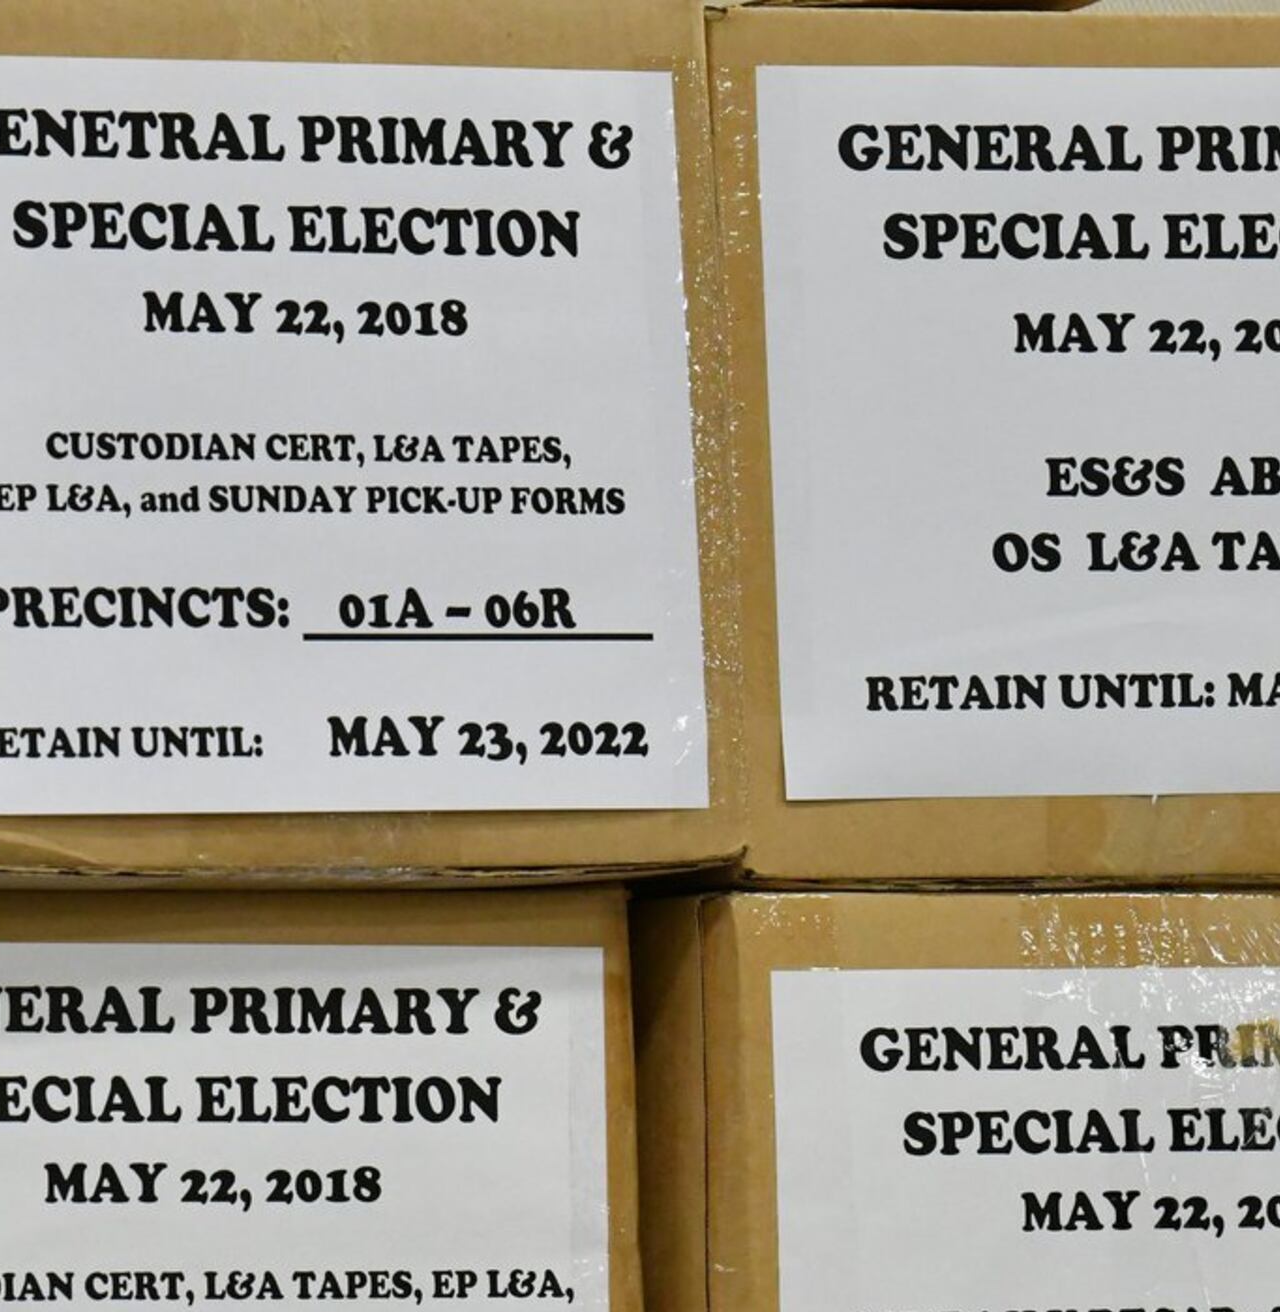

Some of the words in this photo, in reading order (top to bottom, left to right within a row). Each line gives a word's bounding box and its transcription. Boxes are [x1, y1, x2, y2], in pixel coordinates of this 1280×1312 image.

[298, 116, 573, 168] PRIMARY
[588, 121, 633, 169] &
[13, 200, 275, 252] SPECIAL
[287, 205, 580, 257] ELECTION
[1014, 313, 1135, 353] MAY
[1149, 320, 1221, 361] 22,
[46, 432, 255, 460] CUSTODIAN
[266, 434, 364, 467] CERT,
[373, 435, 445, 462] L&A
[452, 436, 571, 469] TAPES,
[1045, 456, 1185, 497] ES&S
[46, 484, 131, 518] L&A,
[141, 486, 200, 512] and
[209, 485, 357, 513] SUNDAY
[366, 487, 502, 514] PICK-UP
[511, 487, 625, 514] FORMS
[993, 533, 1061, 572] OS
[1087, 531, 1200, 571] L&A
[339, 587, 433, 628] 01A
[485, 588, 576, 628] 06R
[131, 727, 263, 757] UNTIL:
[327, 716, 444, 757] MAY
[458, 722, 527, 765] 23,
[540, 722, 648, 757] 2022
[196, 1076, 502, 1123] ELECTION
[85, 1272, 194, 1306] CERT,
[204, 1271, 284, 1300] L&A
[293, 1271, 422, 1305] TAPES,
[432, 1270, 477, 1298] EP
[487, 1269, 574, 1304] L&A,
